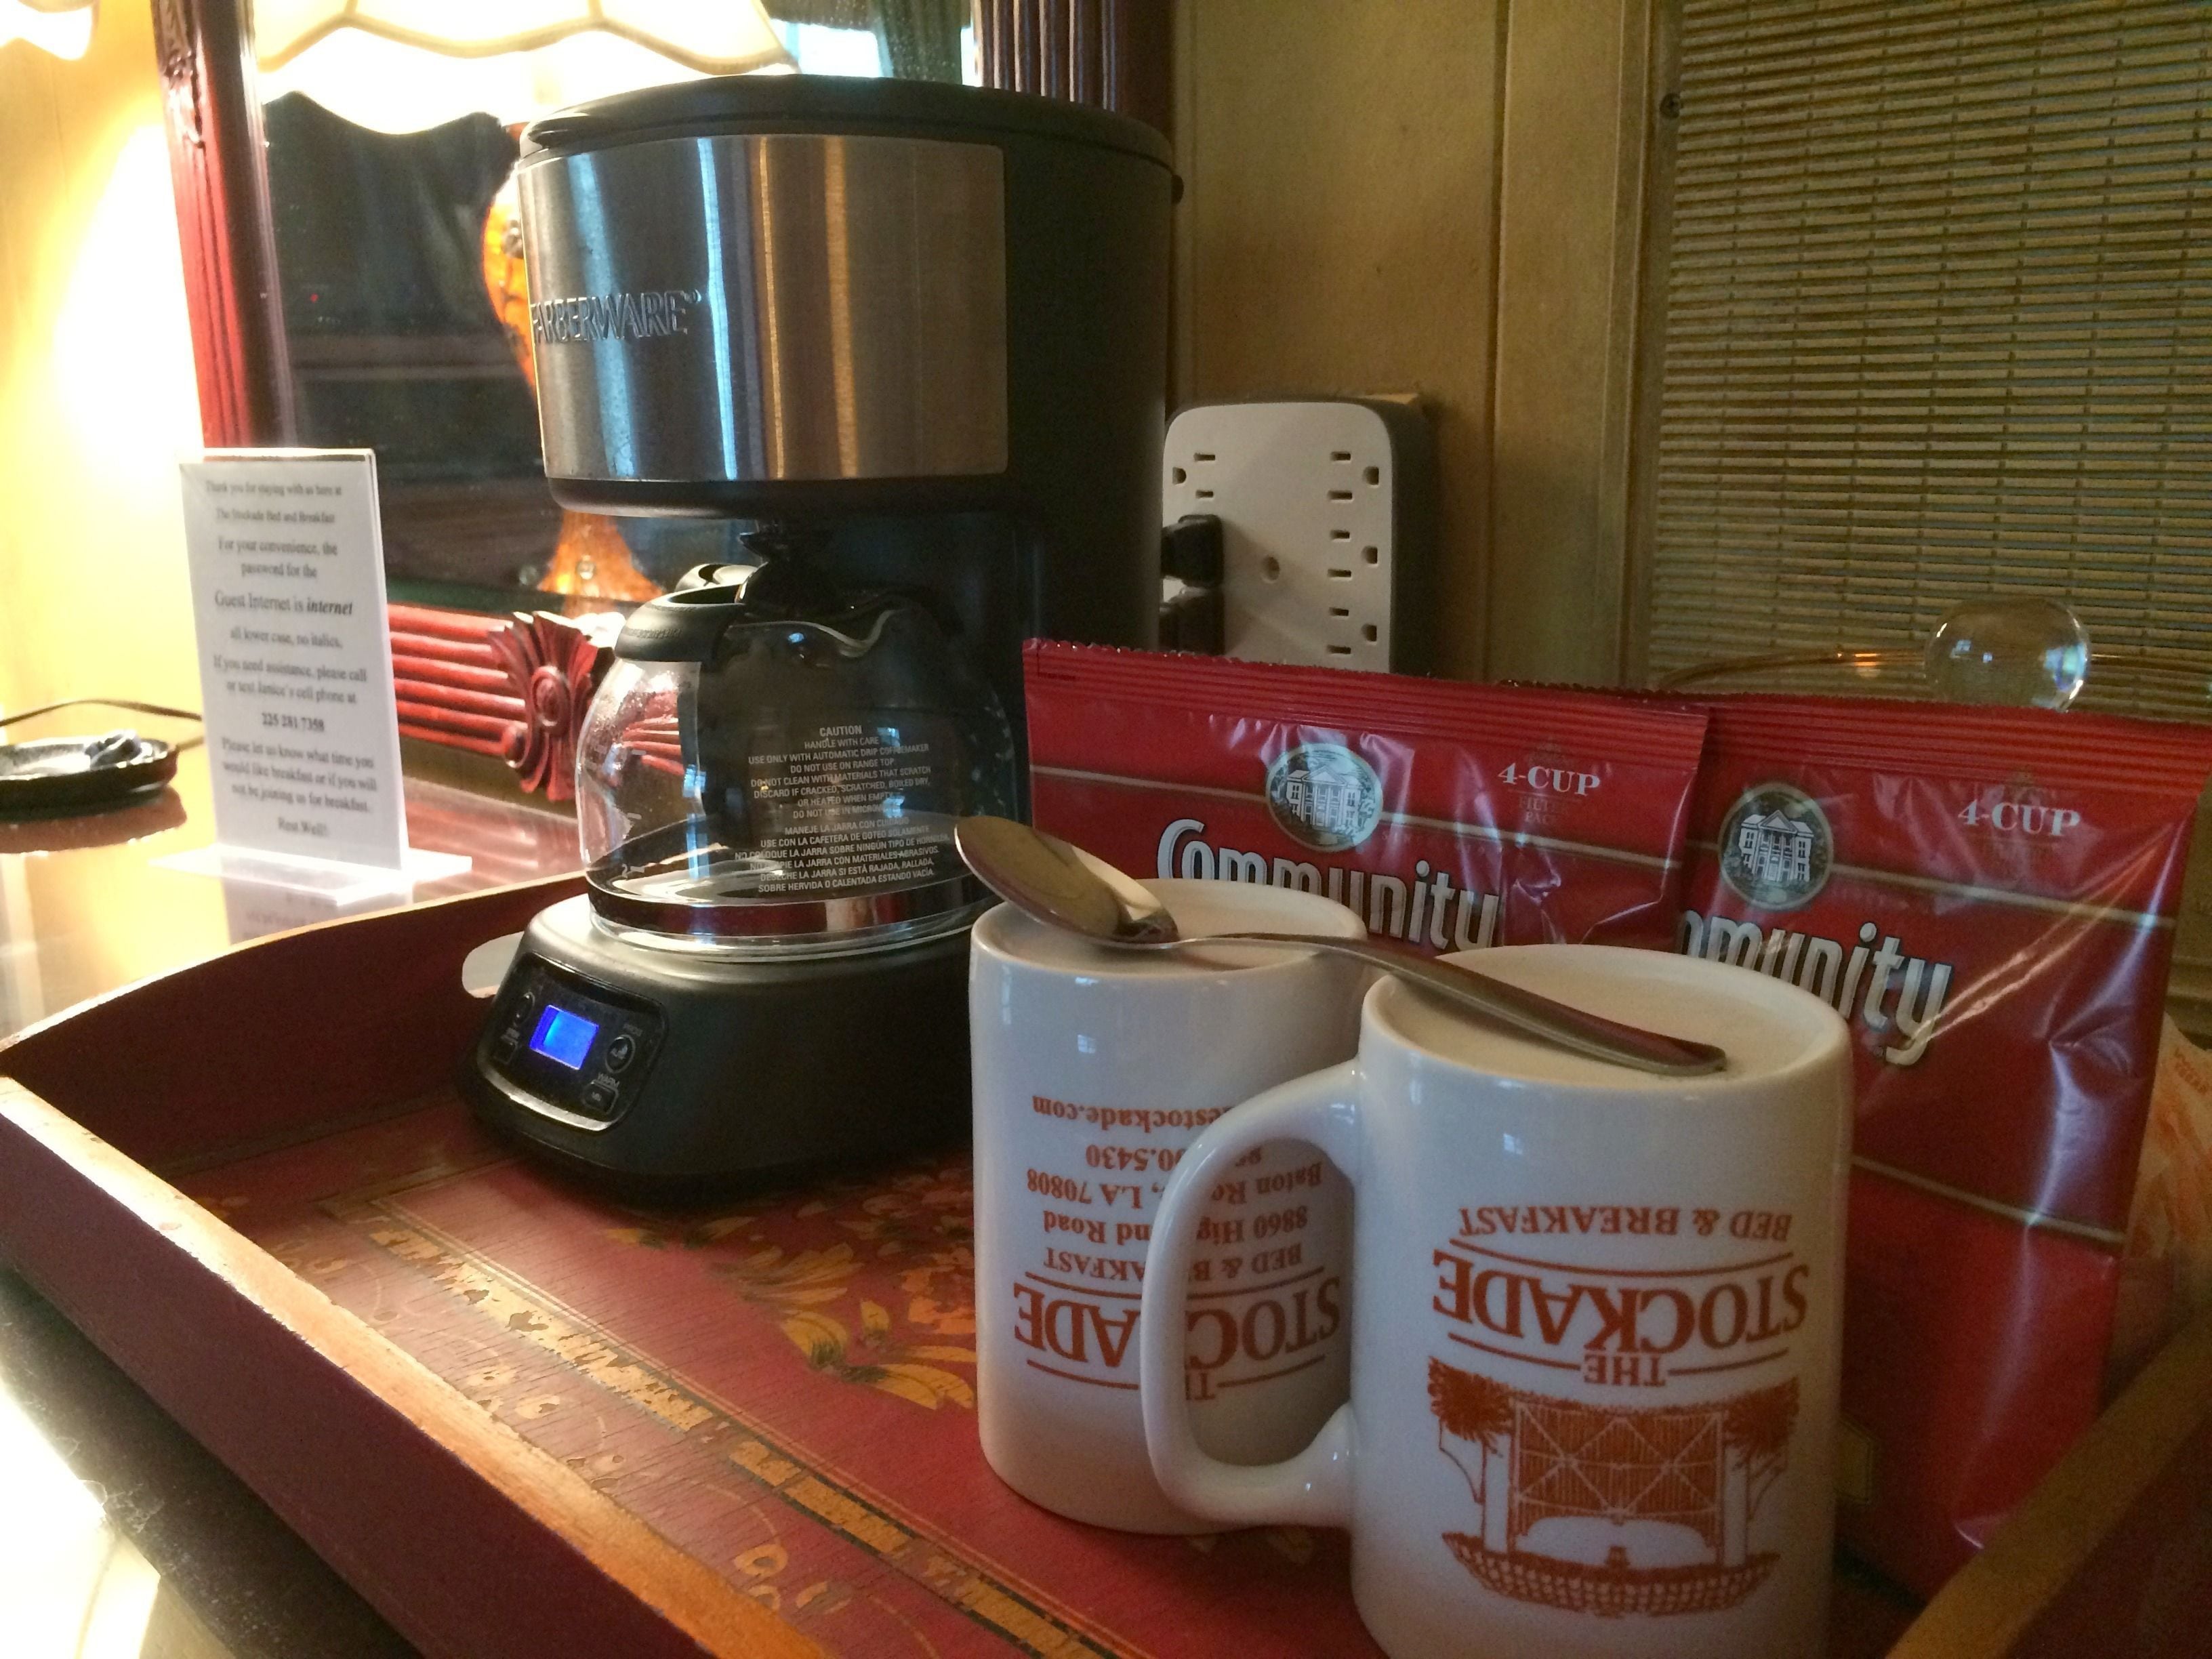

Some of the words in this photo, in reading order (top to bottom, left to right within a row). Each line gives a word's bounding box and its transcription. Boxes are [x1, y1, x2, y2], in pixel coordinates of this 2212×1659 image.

[249, 593, 291, 611] Internet
[306, 598, 353, 615] internet
[804, 739, 836, 748] HANDLE
[837, 738, 857, 747] WITH
[859, 737, 879, 745] CARE
[819, 725, 862, 737] CAUTION
[748, 756, 764, 764] USE
[766, 754, 787, 763] ONLY
[790, 753, 811, 762] WITH
[813, 750, 859, 760] AUTOMATIC
[861, 747, 878, 756] DRIP
[790, 764, 802, 773] DO
[804, 764, 821, 772] NOT
[822, 762, 838, 771] USE
[840, 761, 851, 770] ON
[853, 759, 878, 769] RANGE
[880, 758, 894, 766] TOP
[751, 779, 762, 787] DO
[765, 777, 781, 787] NOT
[783, 776, 810, 785] CLEAN
[811, 774, 832, 783] WITH
[833, 771, 878, 781] MATERIALS
[879, 769, 898, 777] THAT
[900, 766, 931, 775] SCRATCH
[1498, 762, 1601, 796] 4-CUP
[754, 789, 790, 798] DISCARD
[792, 788, 799, 796] IF
[801, 785, 840, 796] CRACKED,
[798, 798, 808, 806] OR
[811, 796, 840, 805] HEATED
[843, 794, 866, 803] WHEN
[794, 811, 804, 819] DO
[806, 809, 823, 817] NOT
[852, 804, 890, 813] MICROW
[1958, 798, 2081, 836] 4-CUP
[760, 840, 777, 848] USE
[779, 838, 796, 846] CON
[798, 838, 808, 846] LA
[810, 834, 848, 844] CAFETERA
[851, 833, 861, 841] DE
[862, 830, 886, 840] GOTEO
[888, 825, 930, 837] SOLAMENTE
[785, 825, 819, 835] MANEJE
[832, 822, 857, 831] JARRA
[764, 860, 792, 869] PIE
[794, 860, 804, 868] LA
[806, 858, 832, 867] JARRA
[834, 856, 851, 865] CON
[852, 851, 897, 863] MATERIALES
[789, 849, 800, 857] LA
[801, 847, 827, 857] JARRA
[830, 844, 855, 854] SOBRE
[888, 839, 904, 848] TIPO
[906, 838, 915, 846] DE
[758, 883, 786, 893] SOBRE
[788, 881, 823, 890] HERVIDA
[832, 876, 877, 887] CALENTADA
[878, 872, 911, 882] ESTANDO
[799, 871, 809, 879] LA
[811, 868, 837, 878] JARRA
[839, 867, 846, 876] SI
[1031, 1095, 1235, 1133] estockade.com
[1027, 1168, 1091, 1204] 70808
[1257, 1162, 1322, 1194] Baton
[1101, 1183, 1143, 1209] LA
[1044, 1210, 1107, 1244] Road
[1117, 1215, 1245, 1245] Hignd
[1254, 1206, 1308, 1235] 8860
[1458, 1204, 1681, 1235] BREAKFAST
[1692, 1209, 1721, 1235] &
[1729, 1210, 1793, 1242] BED
[1044, 1247, 1212, 1282] BAKFAST
[1222, 1258, 1242, 1279] &
[1252, 1243, 1303, 1273] BED
[1433, 1248, 1810, 1355] STOCKADE
[1014, 1276, 1340, 1372] STOCADE
[1583, 1355, 1667, 1387] THE
